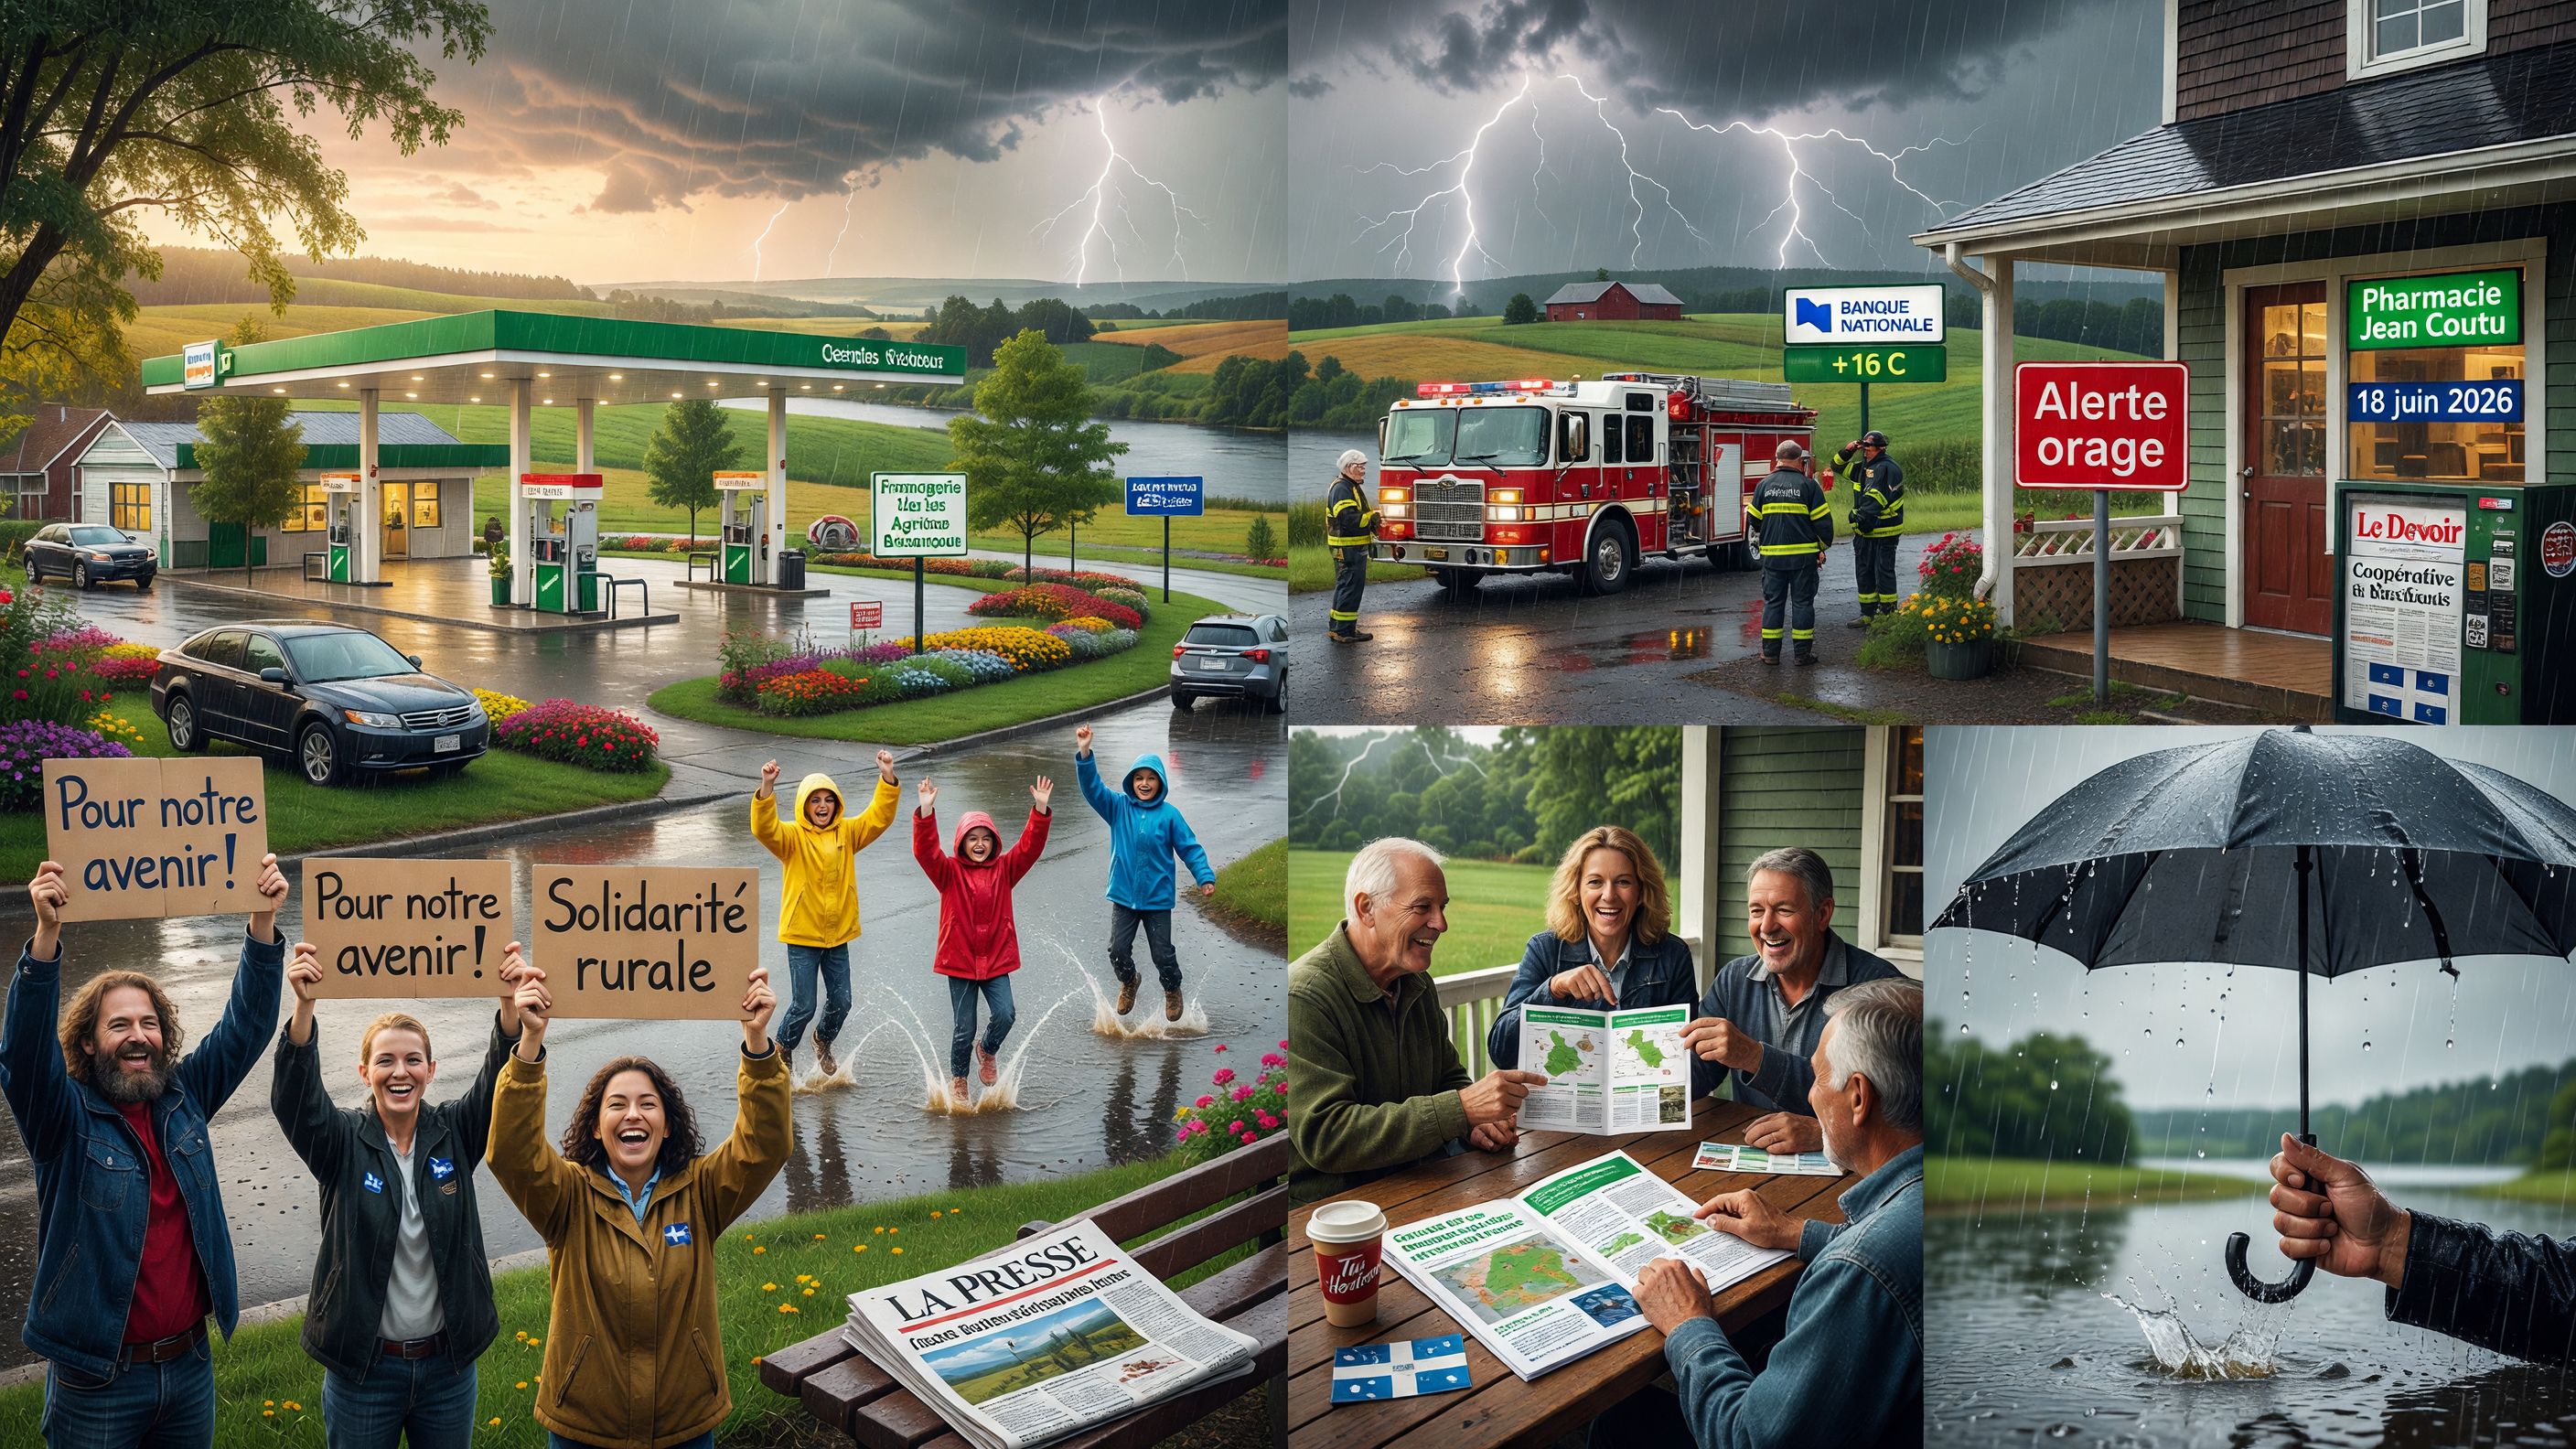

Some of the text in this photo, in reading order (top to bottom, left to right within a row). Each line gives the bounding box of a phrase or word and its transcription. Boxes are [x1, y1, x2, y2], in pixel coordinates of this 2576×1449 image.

[1841, 300, 1909, 315] BANQUE
[2363, 281, 2502, 313] Pharmacie
[1841, 318, 1933, 332] NATIONALE
[2360, 312, 2505, 341] Jean Coutu
[1887, 352, 1905, 376] C
[2034, 381, 2167, 421] Alerte
[2357, 388, 2513, 421] 18 juin 2026
[2037, 436, 2164, 477] orage
[2357, 512, 2463, 543] Le Devoir
[2353, 563, 2455, 587] Coopérative
[56, 775, 258, 831] Pour notre
[83, 833, 237, 891] avenir!
[315, 872, 501, 920] Pour notre
[544, 877, 748, 934] Solidarité
[336, 925, 487, 979] avenir!
[576, 939, 715, 993] rurale
[885, 1288, 956, 1322] LA
[946, 1236, 1099, 1304] PRESSE
